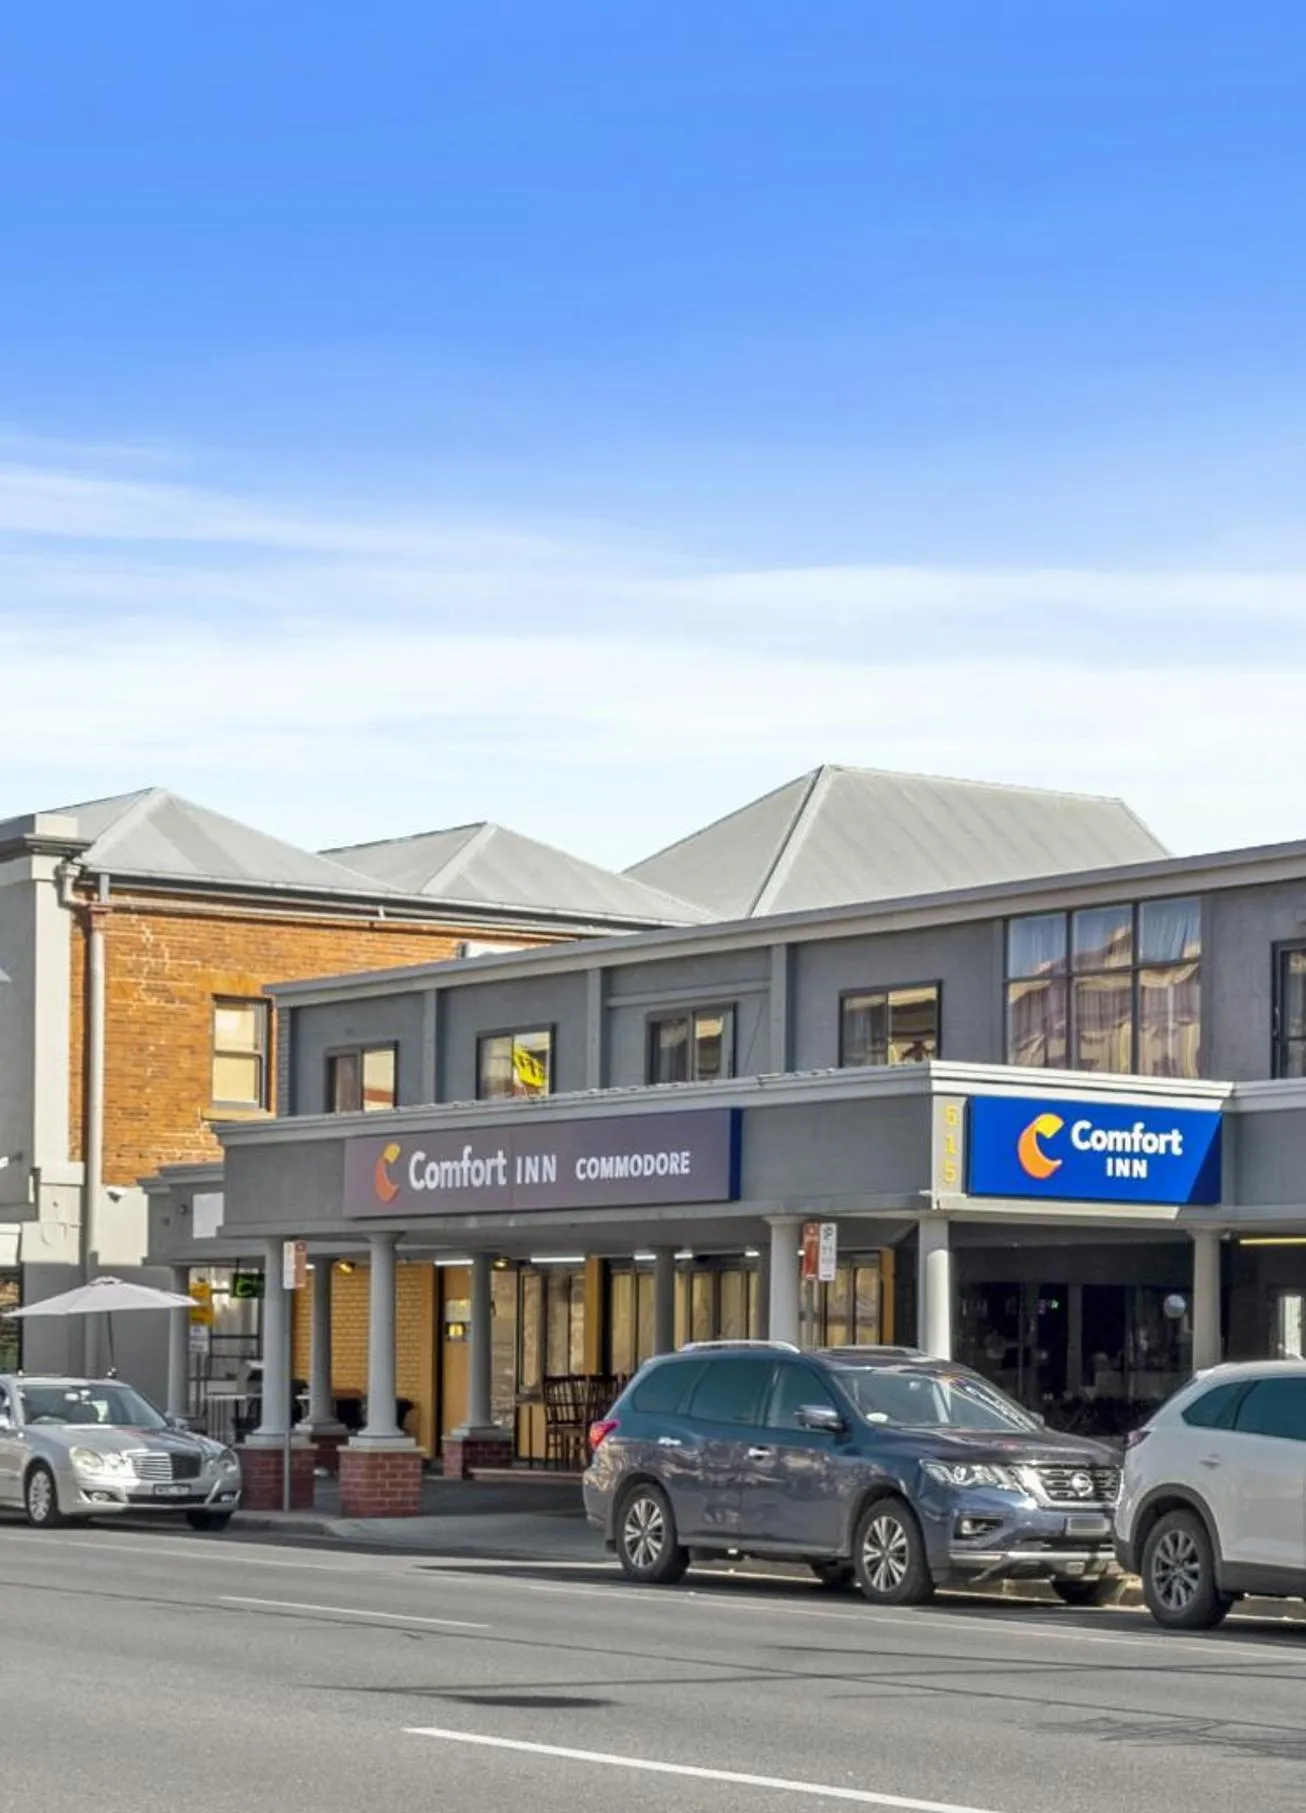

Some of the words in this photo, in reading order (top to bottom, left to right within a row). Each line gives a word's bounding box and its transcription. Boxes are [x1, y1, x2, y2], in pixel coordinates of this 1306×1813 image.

[945, 1104, 958, 1183] 515
[1070, 1120, 1183, 1156] Comfort
[408, 1145, 507, 1190] Comfort
[516, 1155, 557, 1184] INN
[575, 1151, 692, 1181] COMMODORE
[1106, 1157, 1148, 1179] INN
